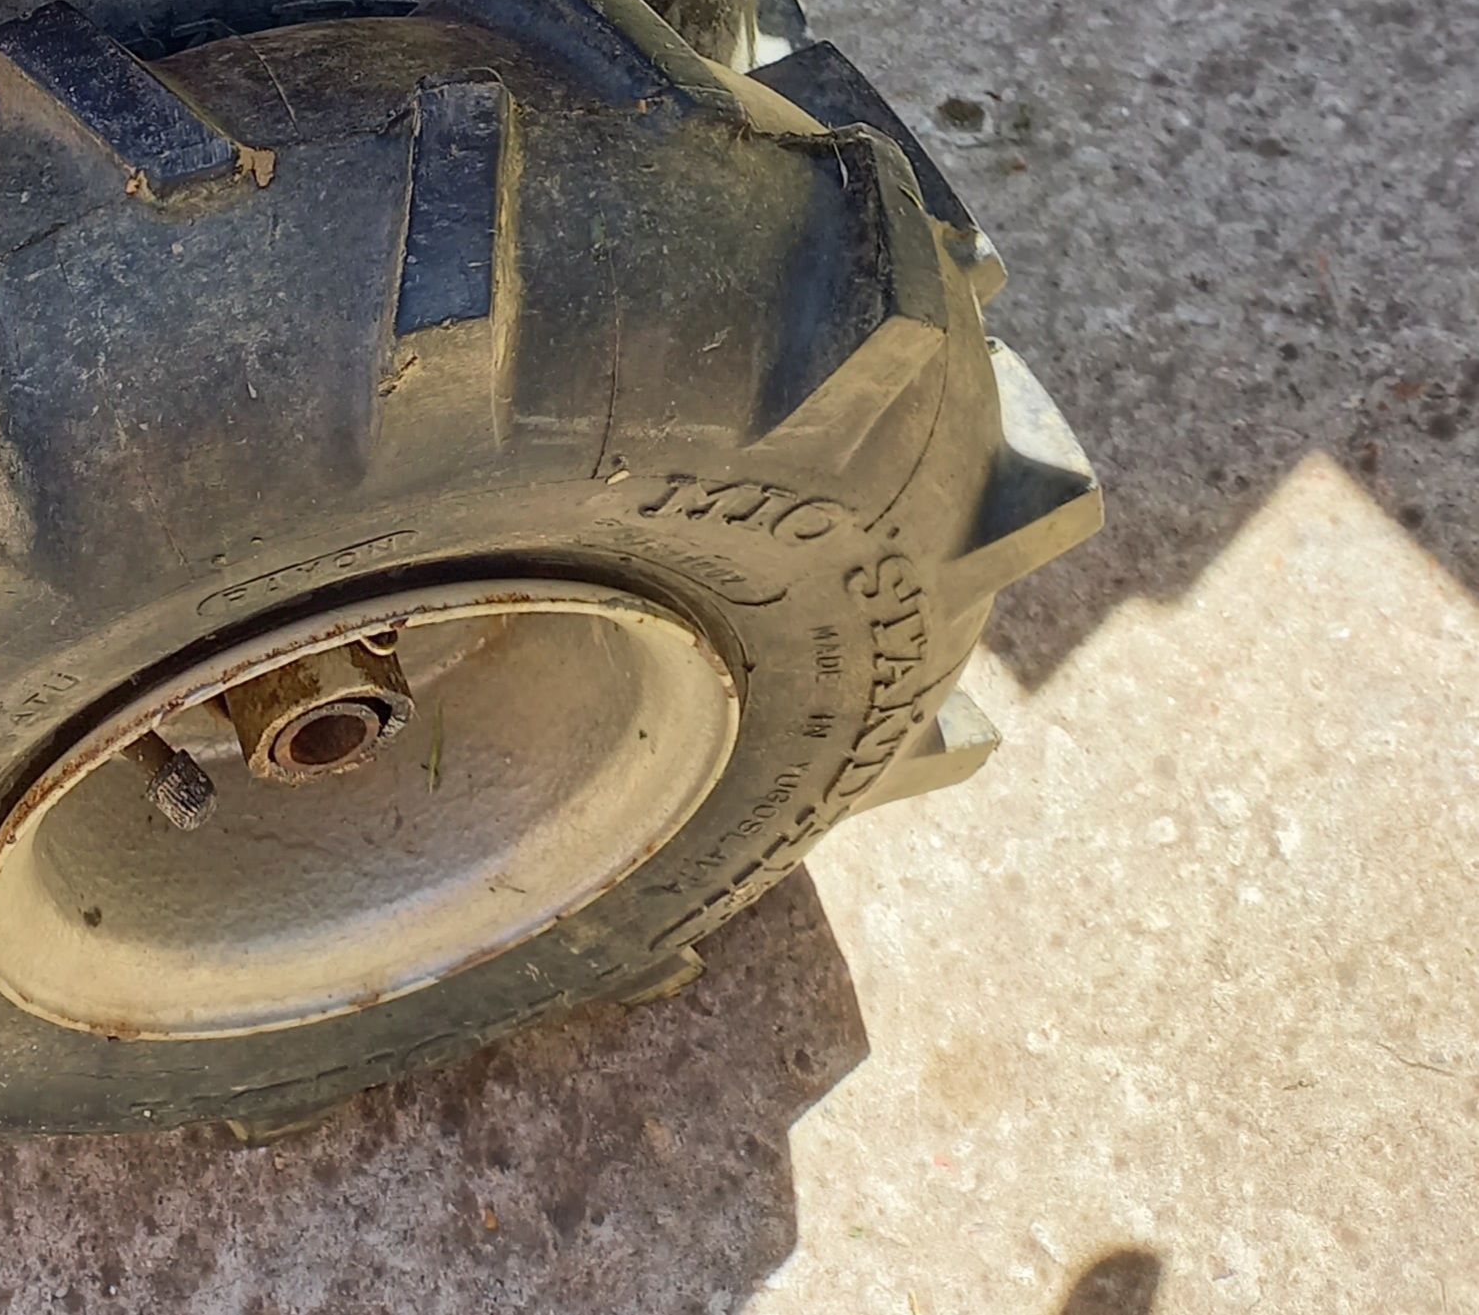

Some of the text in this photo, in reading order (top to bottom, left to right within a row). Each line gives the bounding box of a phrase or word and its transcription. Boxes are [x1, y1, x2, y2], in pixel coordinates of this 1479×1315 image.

[660, 624, 843, 896] MADE IN YUGOSLAVIA
